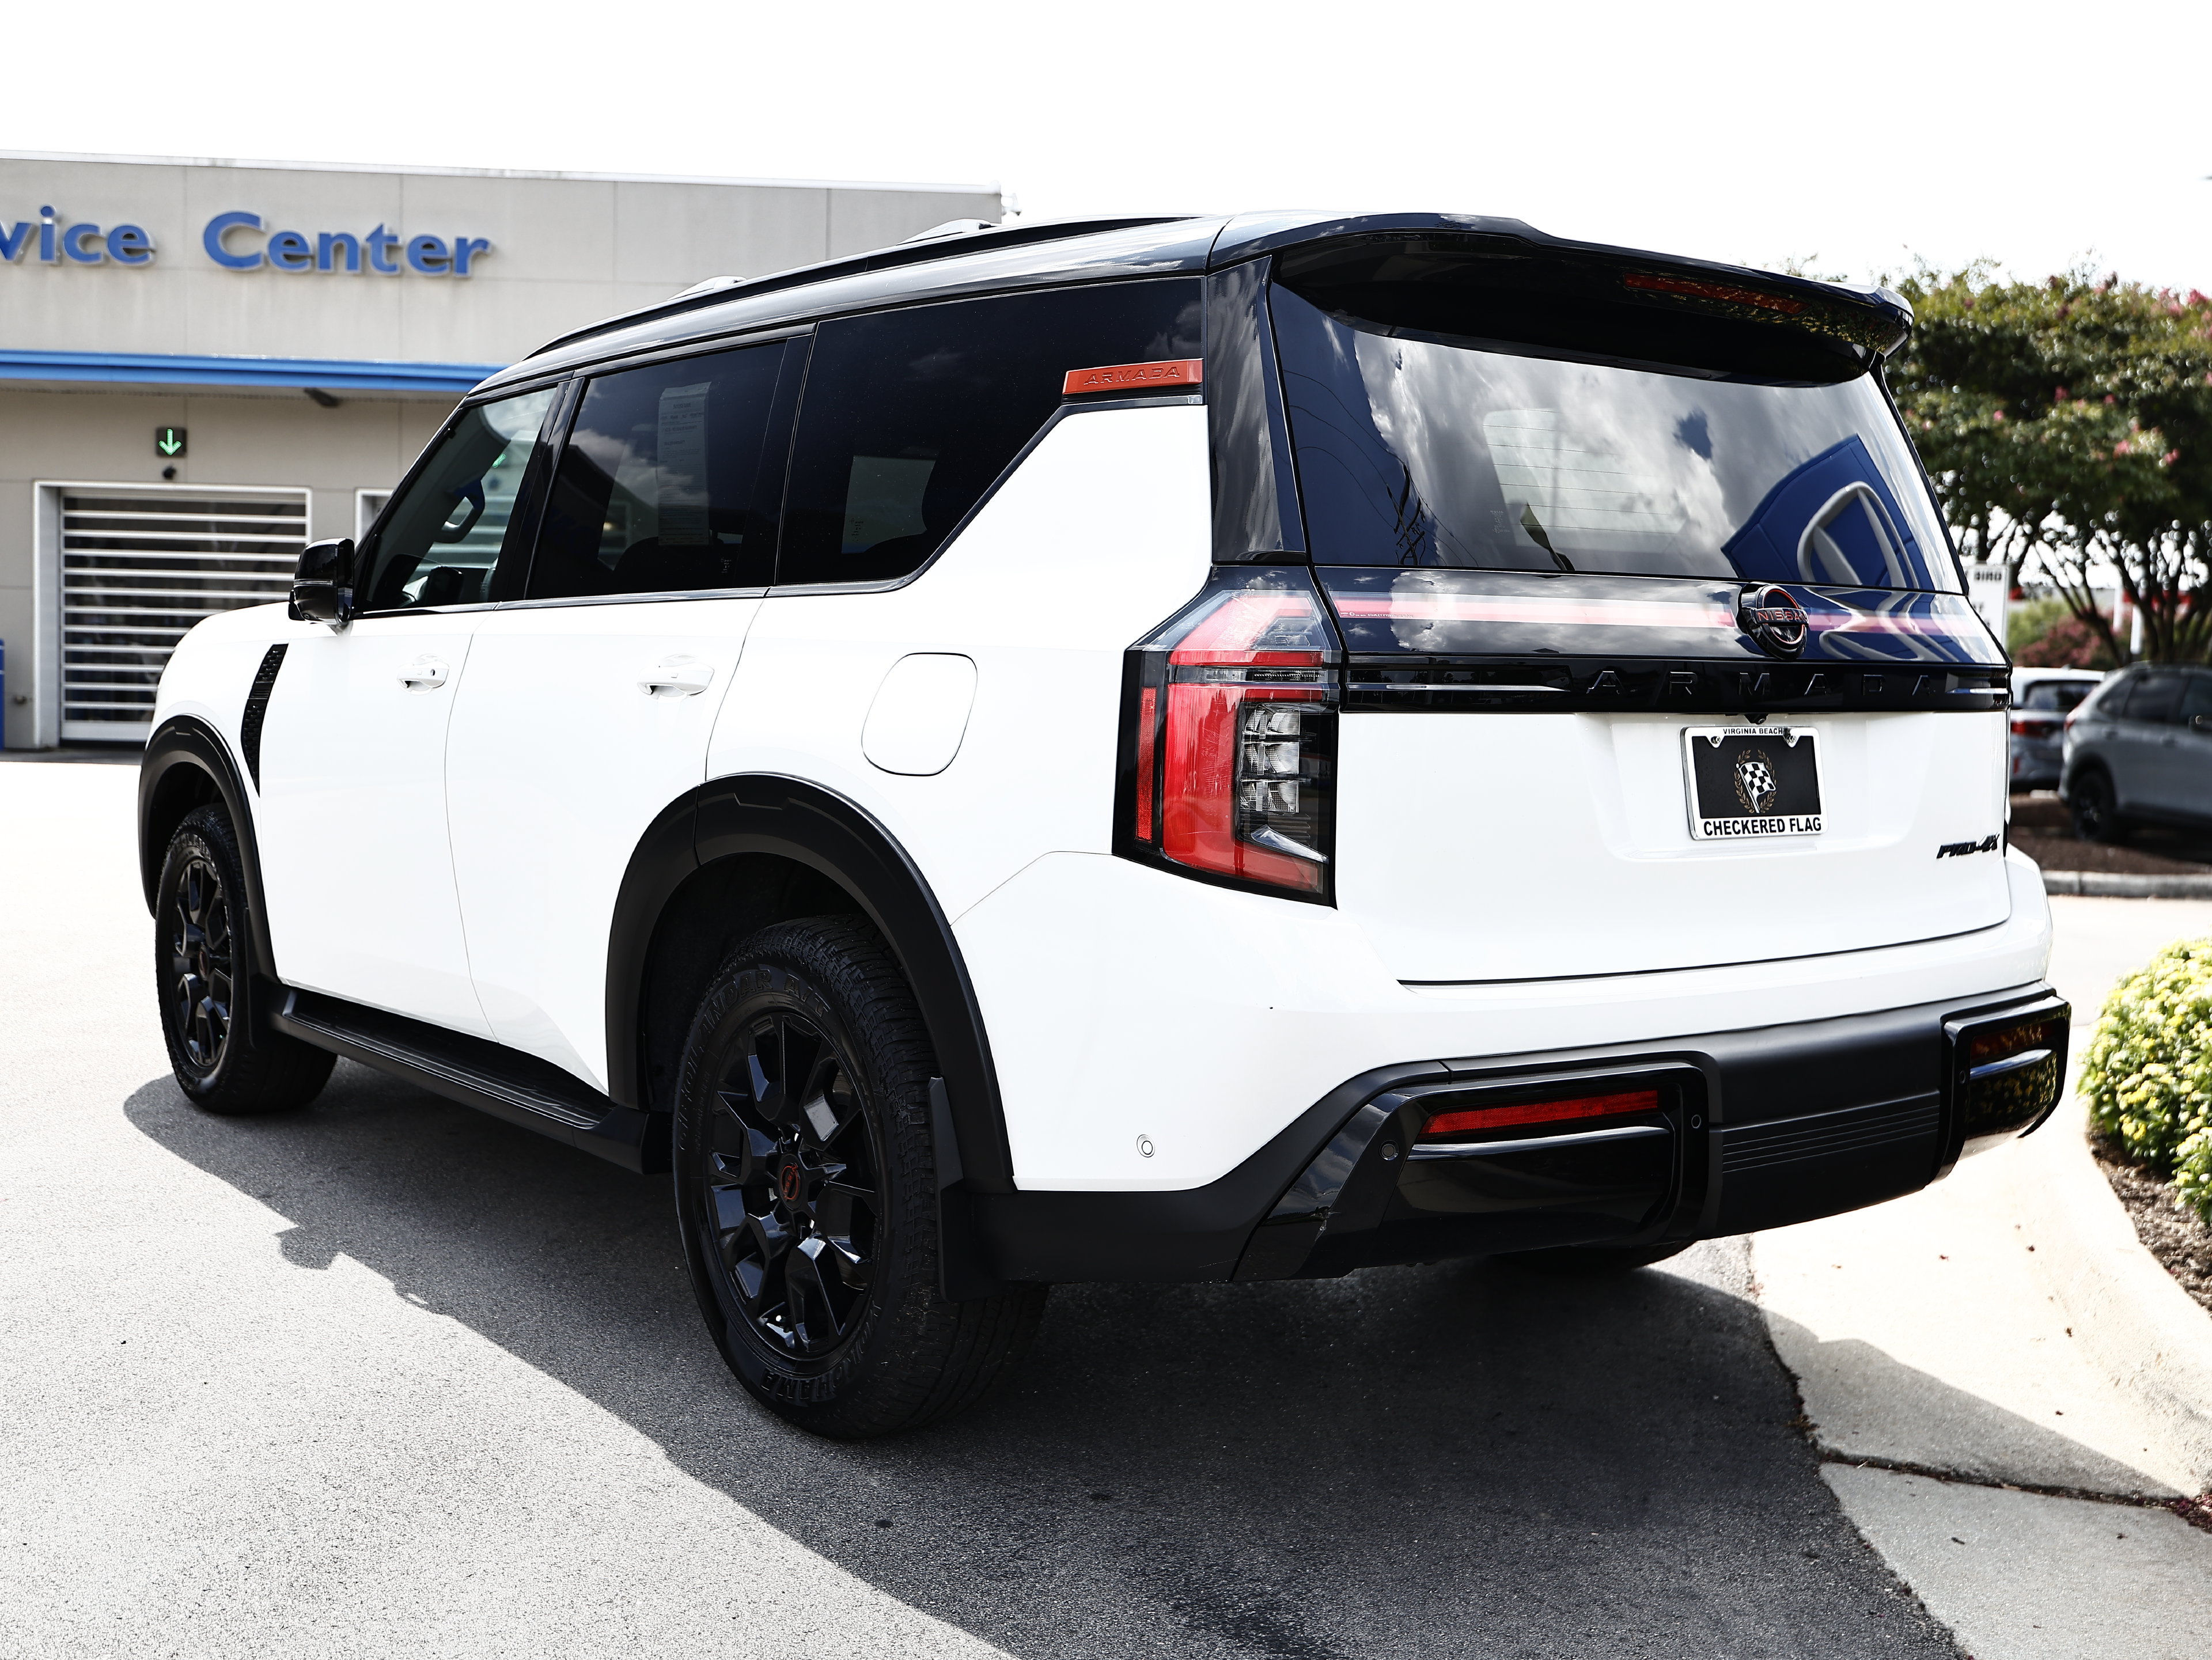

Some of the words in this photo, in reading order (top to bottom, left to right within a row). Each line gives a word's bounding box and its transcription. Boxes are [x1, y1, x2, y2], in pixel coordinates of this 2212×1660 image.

[203, 210, 491, 276] Center
[1083, 366, 1180, 385] ARMADA
[1757, 609, 1808, 621] NISSAN
[1585, 670, 1936, 696] ARMADA
[1703, 819, 1786, 836] CHECKERED
[1789, 817, 1821, 832] FLAG
